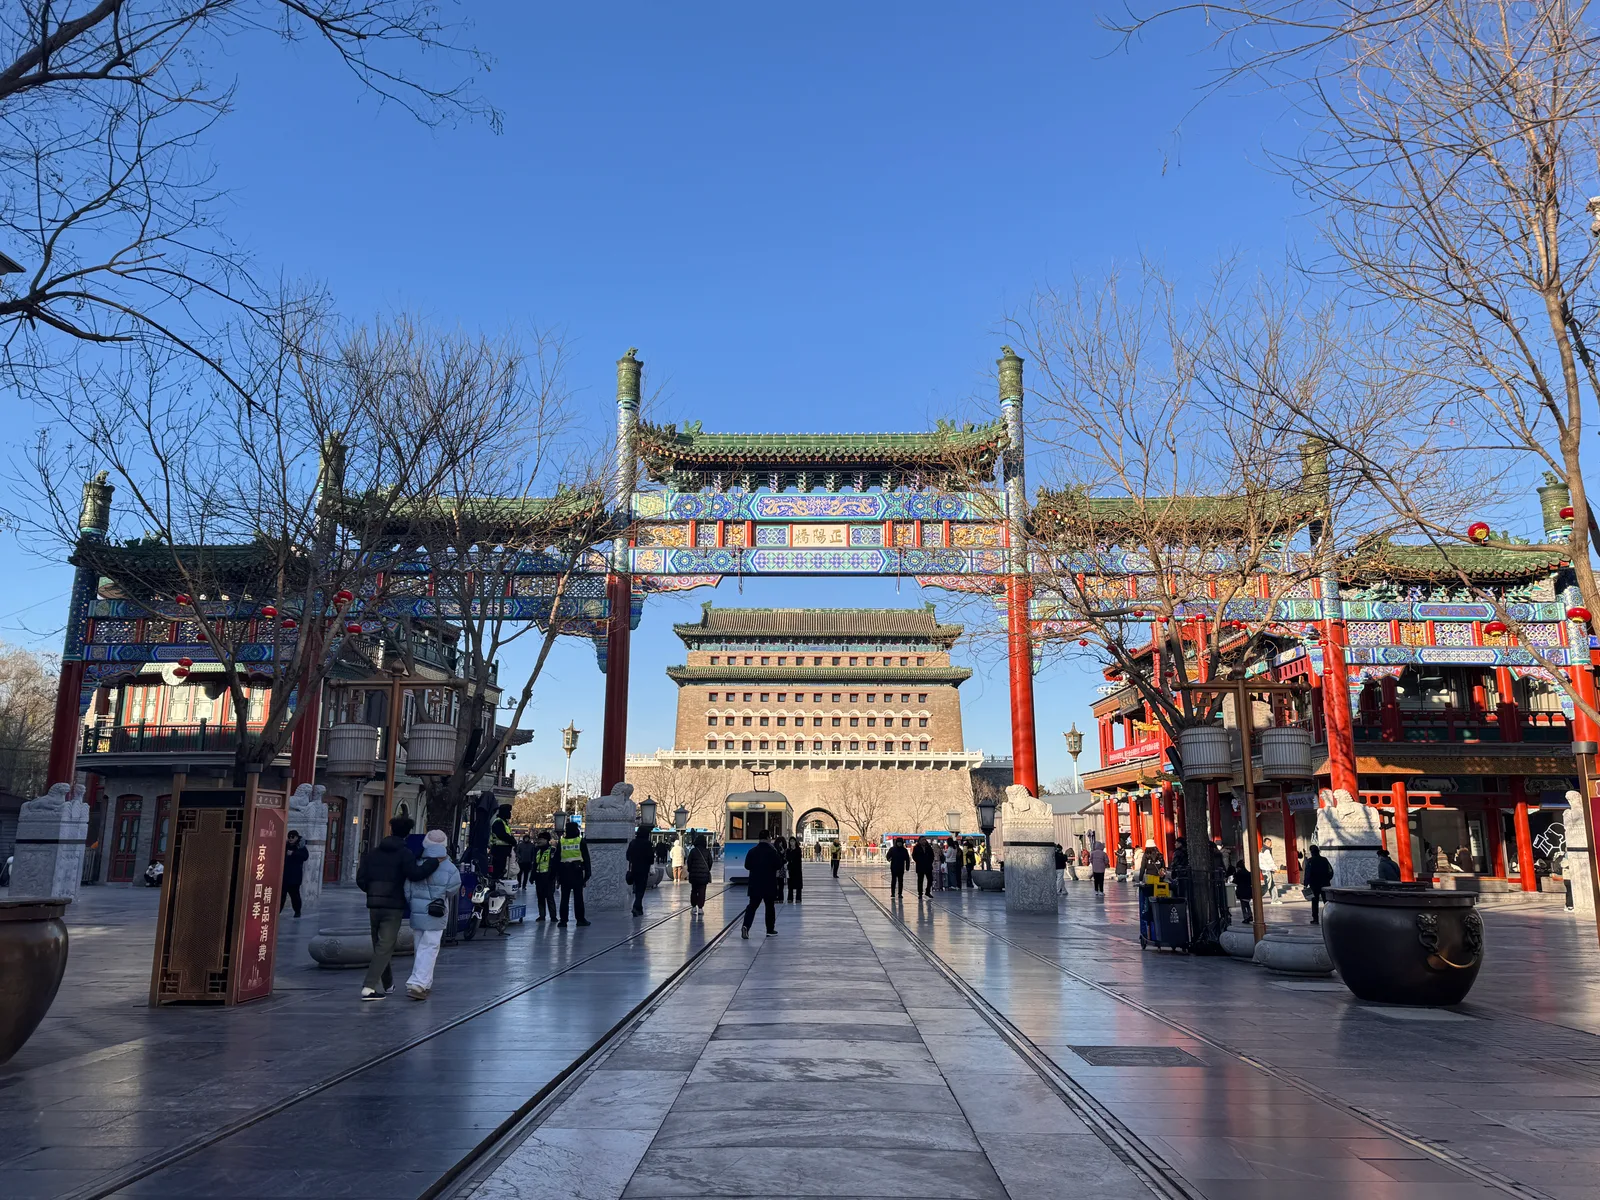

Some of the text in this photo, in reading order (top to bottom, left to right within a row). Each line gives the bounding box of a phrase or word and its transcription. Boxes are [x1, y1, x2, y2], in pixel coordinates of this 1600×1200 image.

[252, 844, 266, 919] 京彩四季
[258, 886, 272, 961] 精品消费
